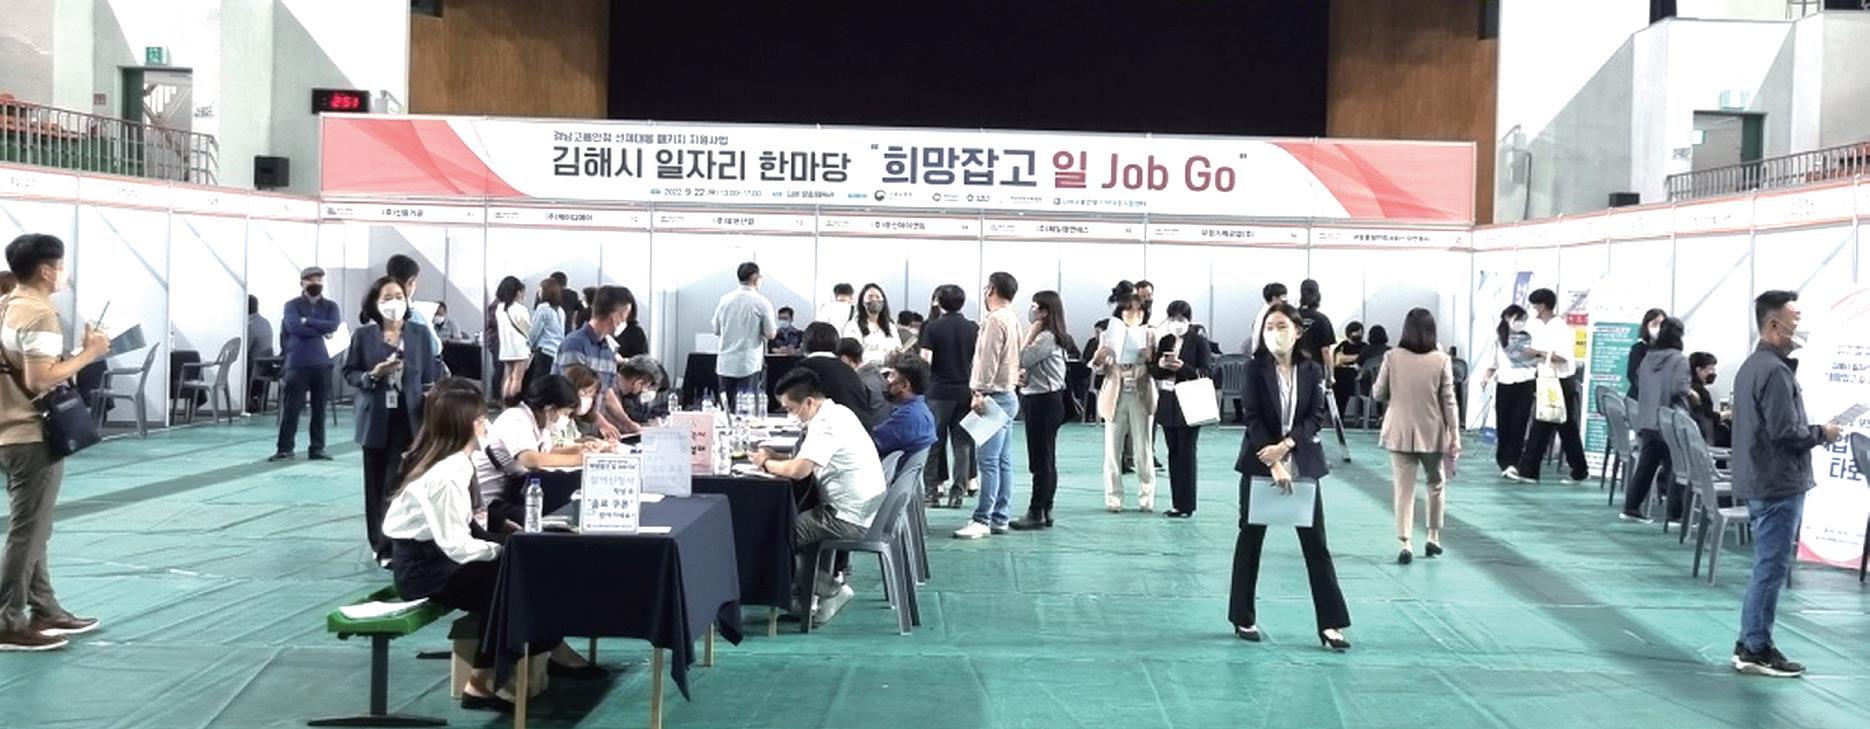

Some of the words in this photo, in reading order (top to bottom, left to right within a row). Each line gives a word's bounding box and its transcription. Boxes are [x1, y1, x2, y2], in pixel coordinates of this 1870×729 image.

[553, 146, 642, 178] 김해시
[656, 149, 745, 180] 일자리
[759, 151, 851, 182] 한마당
[1053, 151, 1086, 188] 일
[1102, 154, 1168, 190] Job
